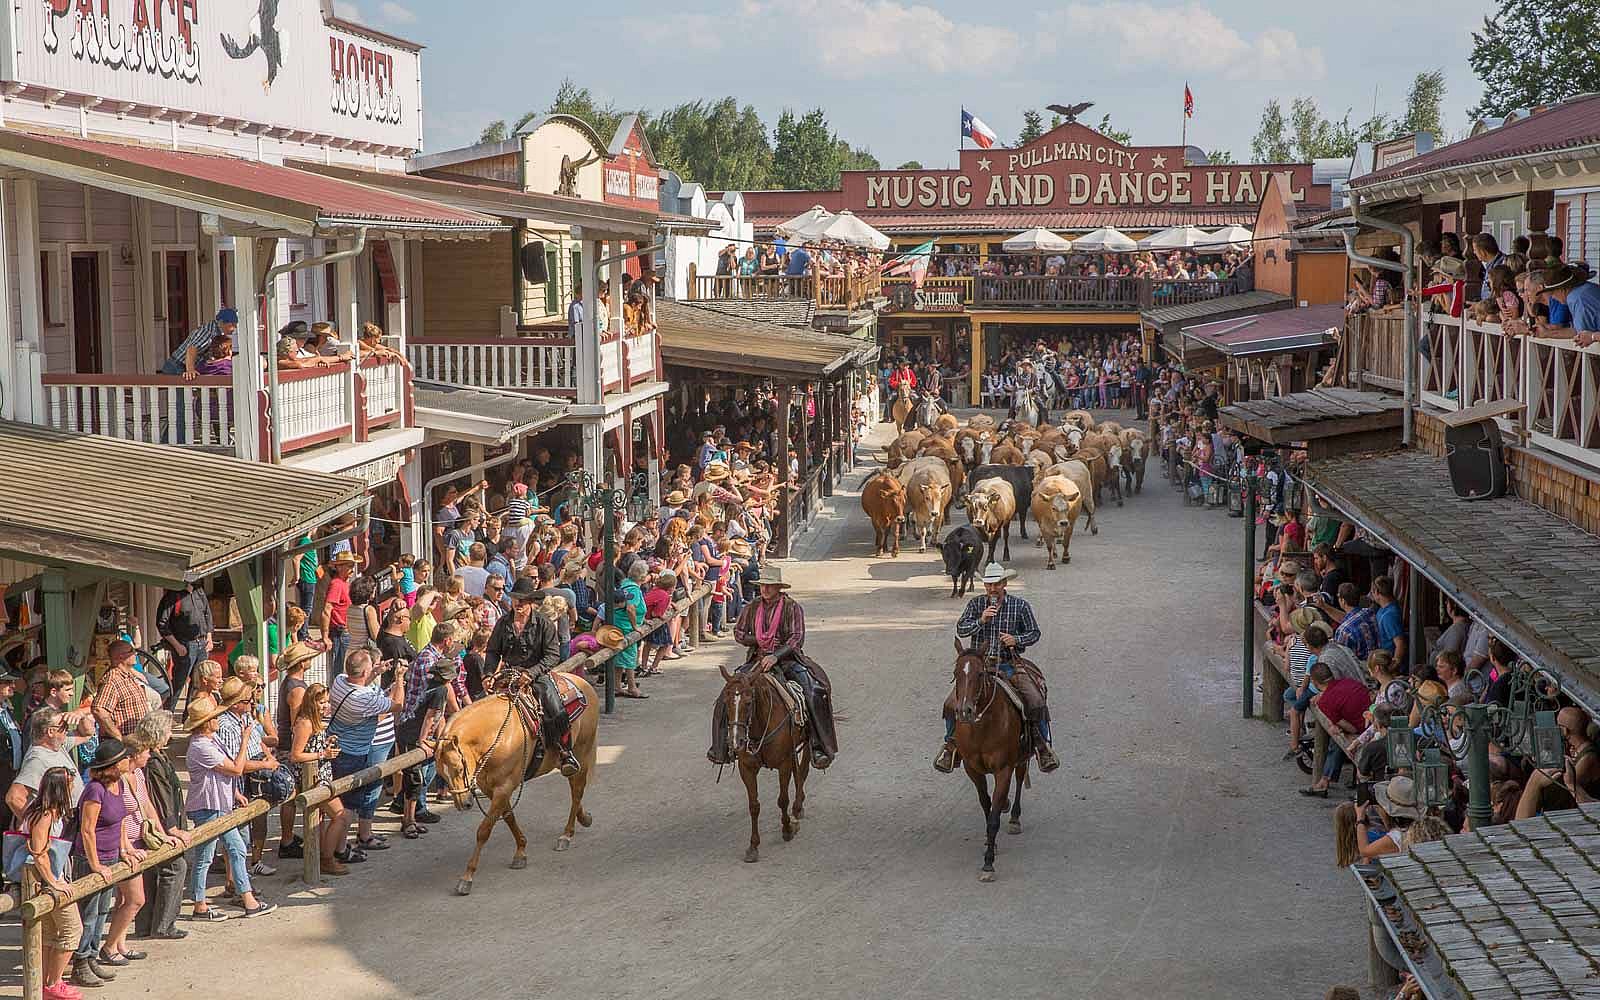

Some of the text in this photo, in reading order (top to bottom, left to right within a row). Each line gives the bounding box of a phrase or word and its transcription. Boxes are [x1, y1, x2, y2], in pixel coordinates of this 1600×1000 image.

[329, 36, 402, 125] HOTEL
[1008, 142, 1139, 172] PULLMAN CITY
[866, 175, 972, 208] MUSIC
[985, 174, 1055, 207] AND
[1068, 172, 1192, 206] DANCE
[914, 288, 959, 311] SALOON
